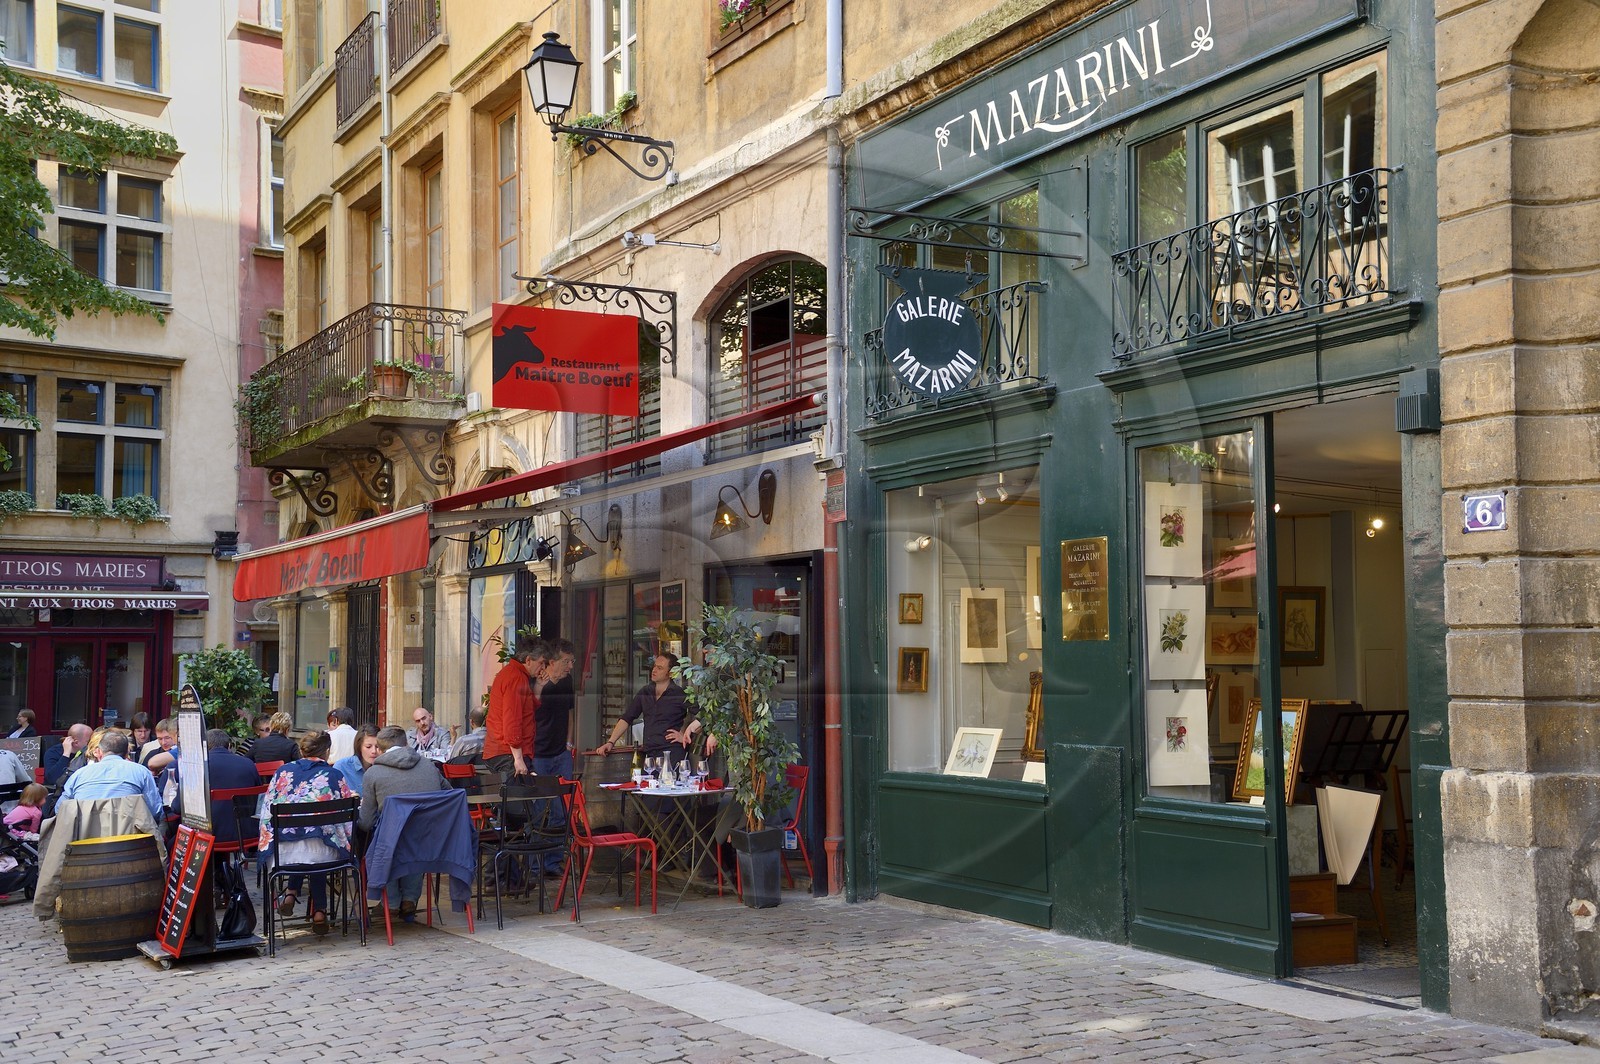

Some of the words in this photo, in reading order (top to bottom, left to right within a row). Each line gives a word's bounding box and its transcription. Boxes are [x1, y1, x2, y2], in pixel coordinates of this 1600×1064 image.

[969, 19, 1165, 158] MAZARINI
[896, 295, 965, 326] GALERIE
[551, 357, 621, 372] Restaurant
[892, 347, 977, 394] MAZARINI
[515, 365, 579, 385] Maître
[579, 371, 634, 388] Boeuf
[1476, 500, 1493, 526] 6
[1067, 552, 1101, 563] MAZARINI
[1072, 543, 1096, 552] GALERIE
[1, 560, 63, 576] TROIS
[75, 562, 147, 578] MARIES
[315, 536, 366, 584] Boeuf
[28, 598, 61, 608] AUX
[71, 598, 115, 609] TROIS
[123, 599, 177, 609] MARIES
